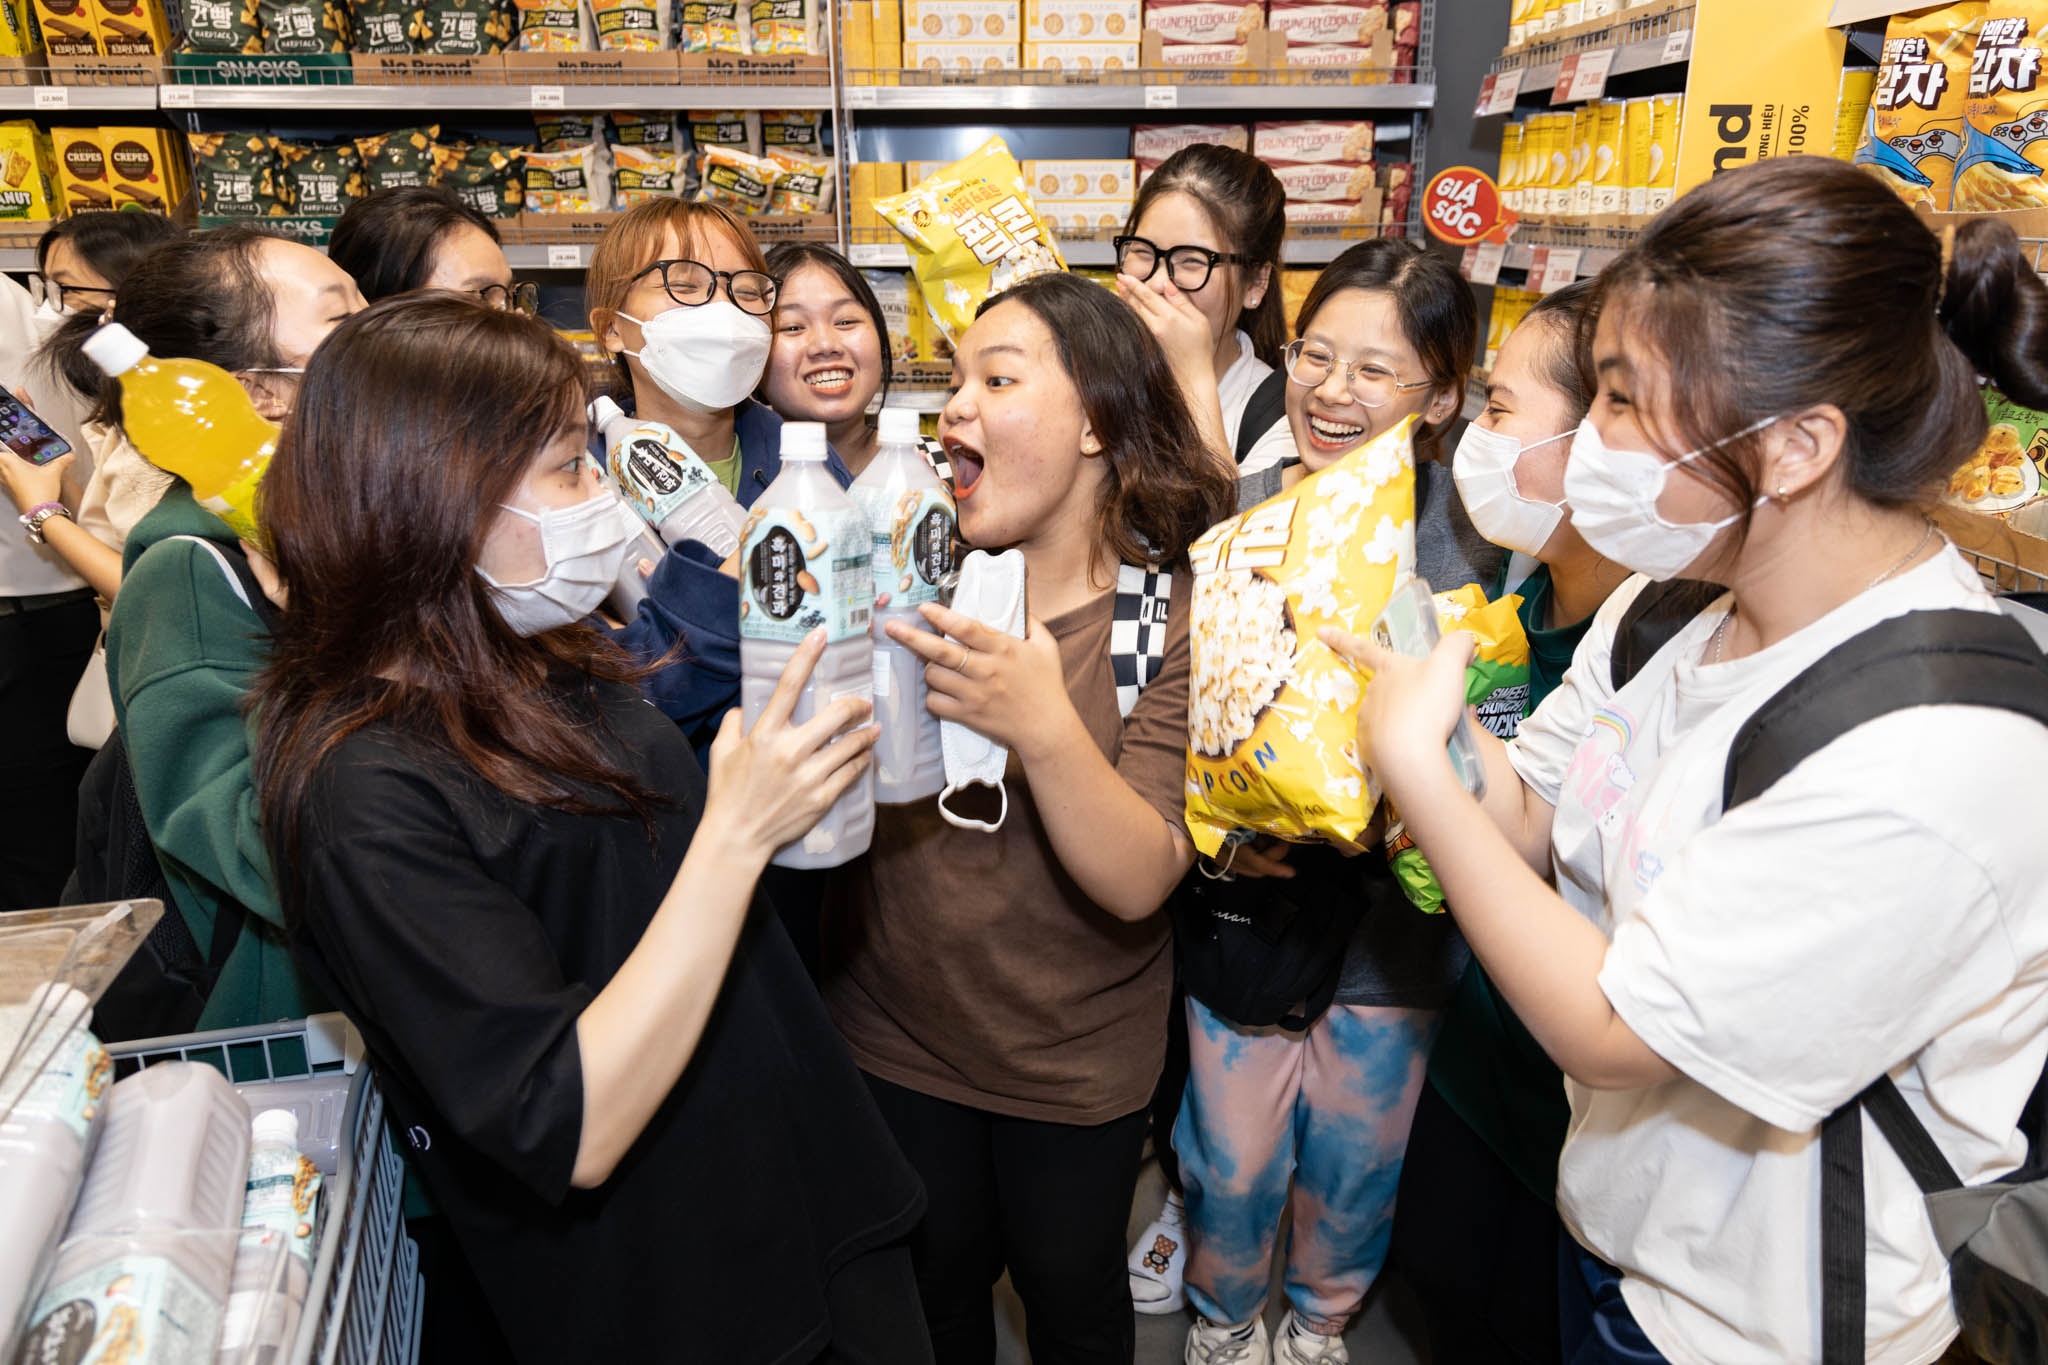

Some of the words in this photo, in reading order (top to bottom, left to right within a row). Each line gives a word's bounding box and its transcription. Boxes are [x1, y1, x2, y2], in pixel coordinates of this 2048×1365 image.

[190, 3, 233, 29] 건빵
[274, 12, 316, 38] 건빵
[366, 19, 404, 45] 건빵
[440, 18, 478, 41] 건빵
[1976, 18, 2026, 47] 백한
[216, 60, 302, 79] SNACKS
[381, 59, 407, 75] No
[412, 59, 473, 77] Brand
[580, 60, 623, 73] Brand
[707, 58, 733, 75] No
[738, 58, 796, 76] Brand
[1970, 48, 2042, 95] 감자
[1877, 62, 1945, 106] 감자
[66, 152, 102, 162] CREPES
[113, 152, 149, 162] CREPES
[0, 191, 31, 205] ANUT
[214, 181, 254, 203] 건빵
[299, 181, 339, 203] 건빵
[1436, 177, 1483, 208] GIÁ
[955, 195, 1041, 266] 팝콘
[1432, 200, 1482, 237] SỐC
[1188, 741, 1279, 795] OPCORN
